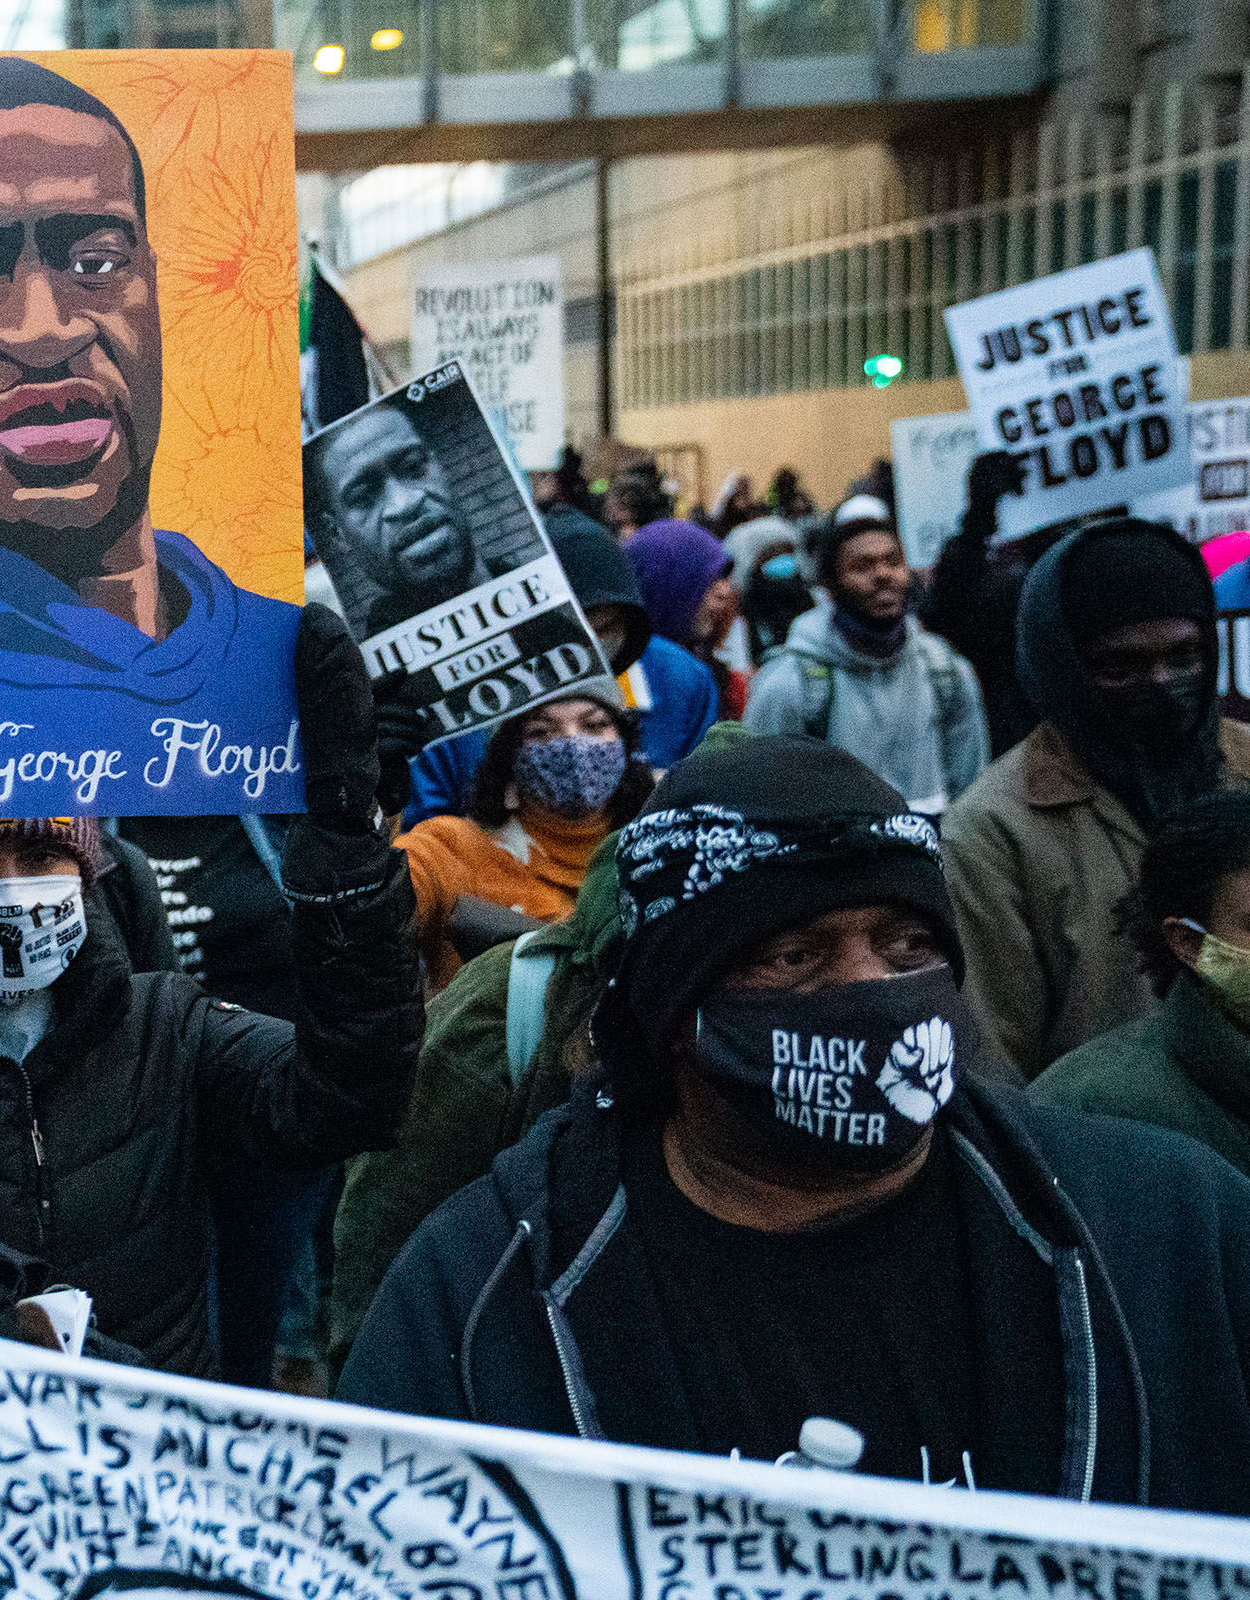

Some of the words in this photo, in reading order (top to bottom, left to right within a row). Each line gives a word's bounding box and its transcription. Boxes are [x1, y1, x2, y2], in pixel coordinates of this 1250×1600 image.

[976, 289, 1151, 371] JUSTICE
[424, 364, 461, 388] CAIR
[997, 365, 1168, 443] GEORGE
[373, 573, 551, 677] JUSTICE
[417, 641, 593, 732] LOYD
[449, 643, 508, 682] FOR
[143, 717, 300, 798] Floyd
[771, 1028, 868, 1077] BLACK
[771, 1065, 854, 1110] LIVES
[773, 1098, 888, 1146] MATTER
[656, 1530, 940, 1585] STERLING
